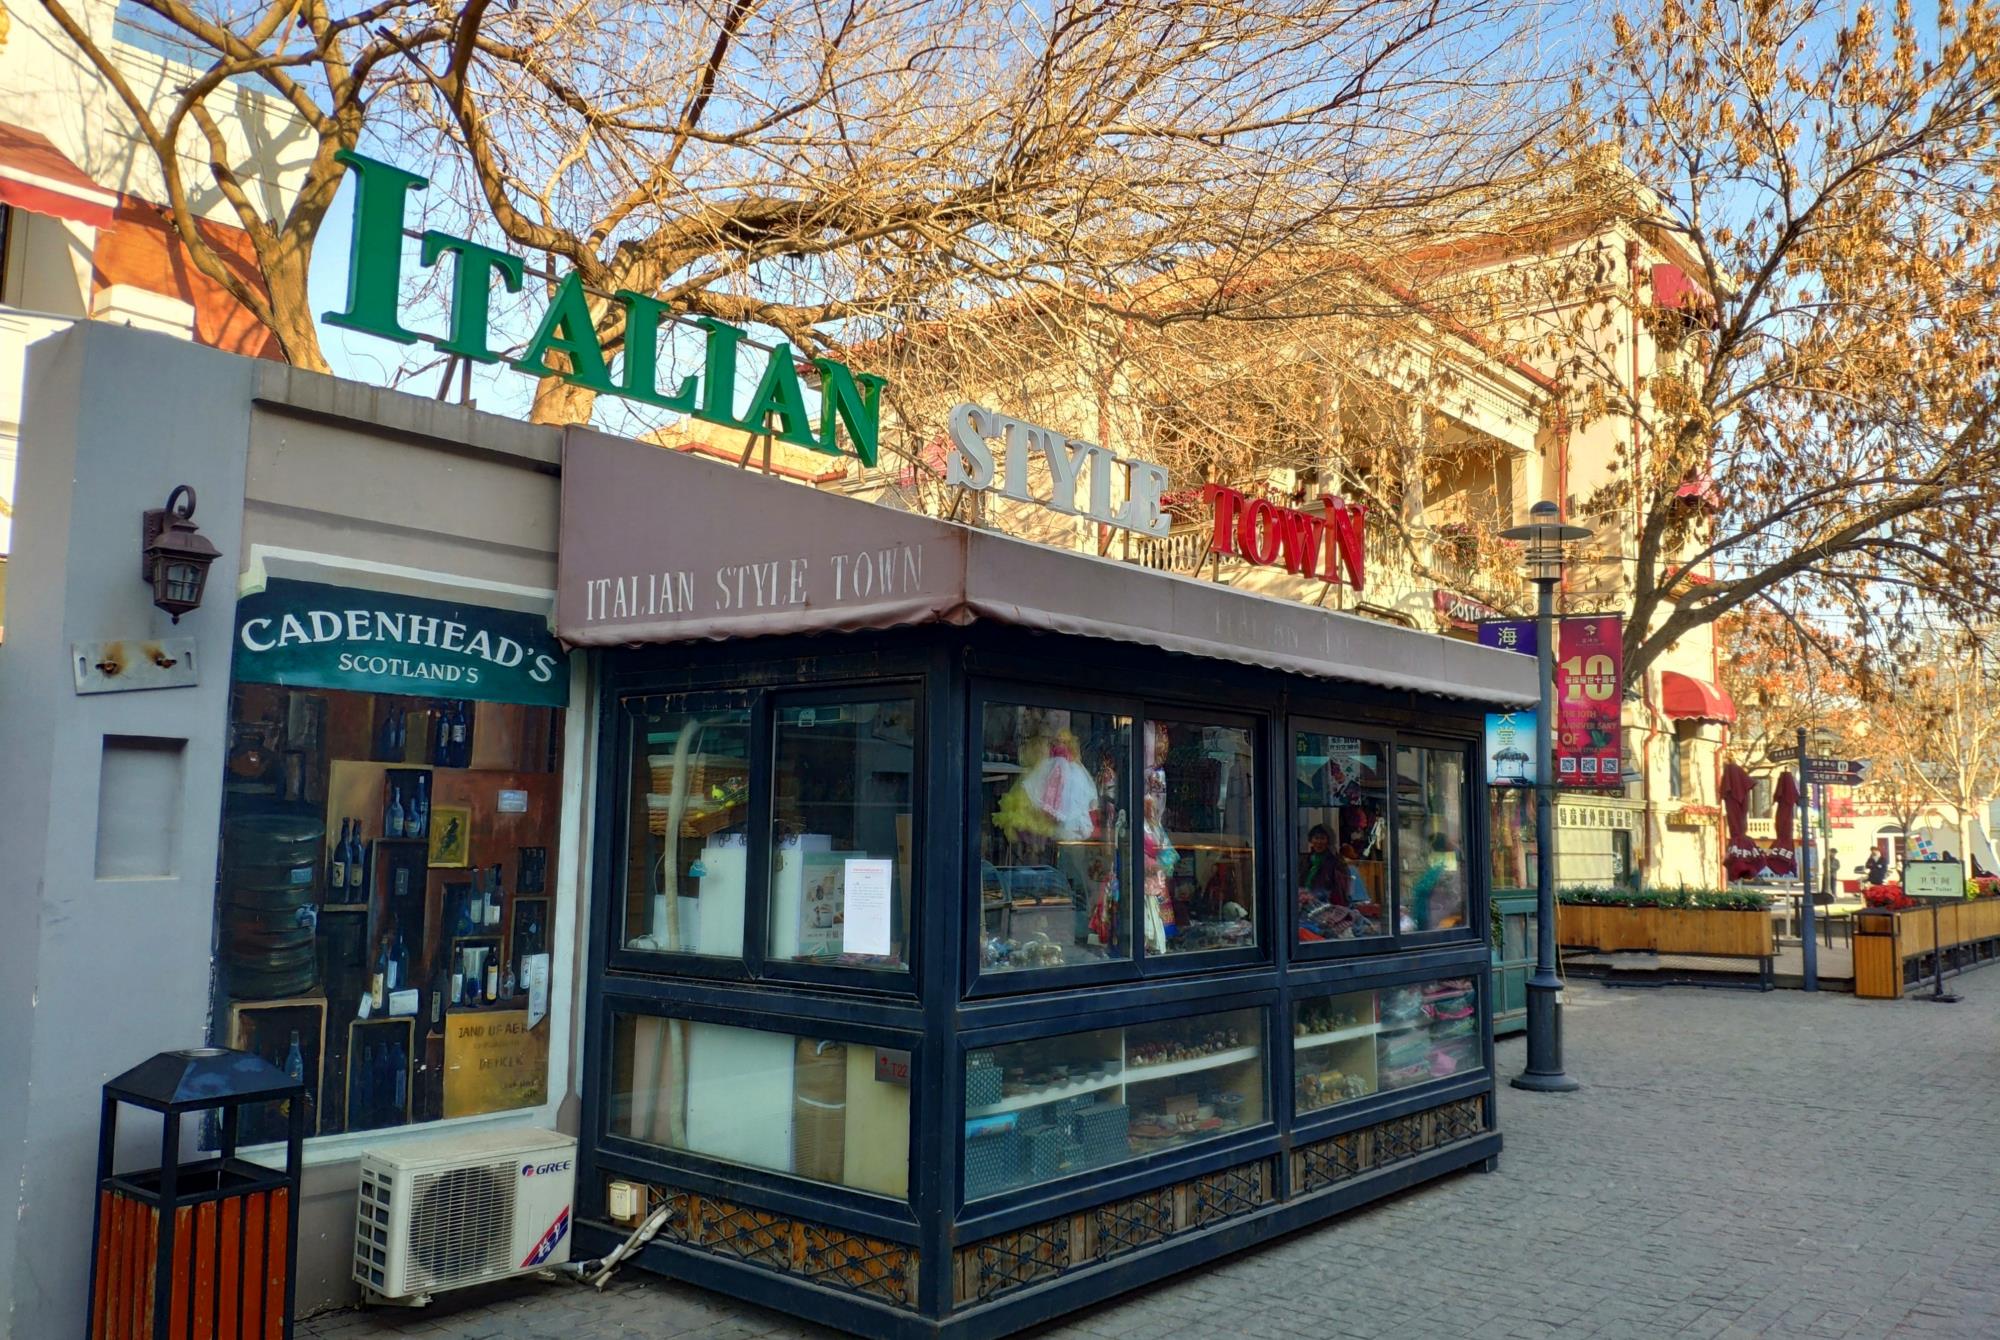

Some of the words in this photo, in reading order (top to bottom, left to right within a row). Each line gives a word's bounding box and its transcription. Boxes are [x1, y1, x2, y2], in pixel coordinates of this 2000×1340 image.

[322, 149, 887, 468] ITALIAN
[947, 403, 1172, 537] STYLE
[1204, 484, 1369, 591] TOWN
[586, 571, 695, 621] ITALIAN
[716, 558, 808, 610] STYLE
[831, 544, 923, 601] TOWN
[241, 610, 557, 683] CADENHEAD'S
[1497, 626, 1517, 651] 海
[338, 653, 479, 684] SCOTLAND'S
[1561, 654, 1614, 701] 10
[1562, 732, 1580, 745] OF
[536, 1160, 572, 1175] GREE
